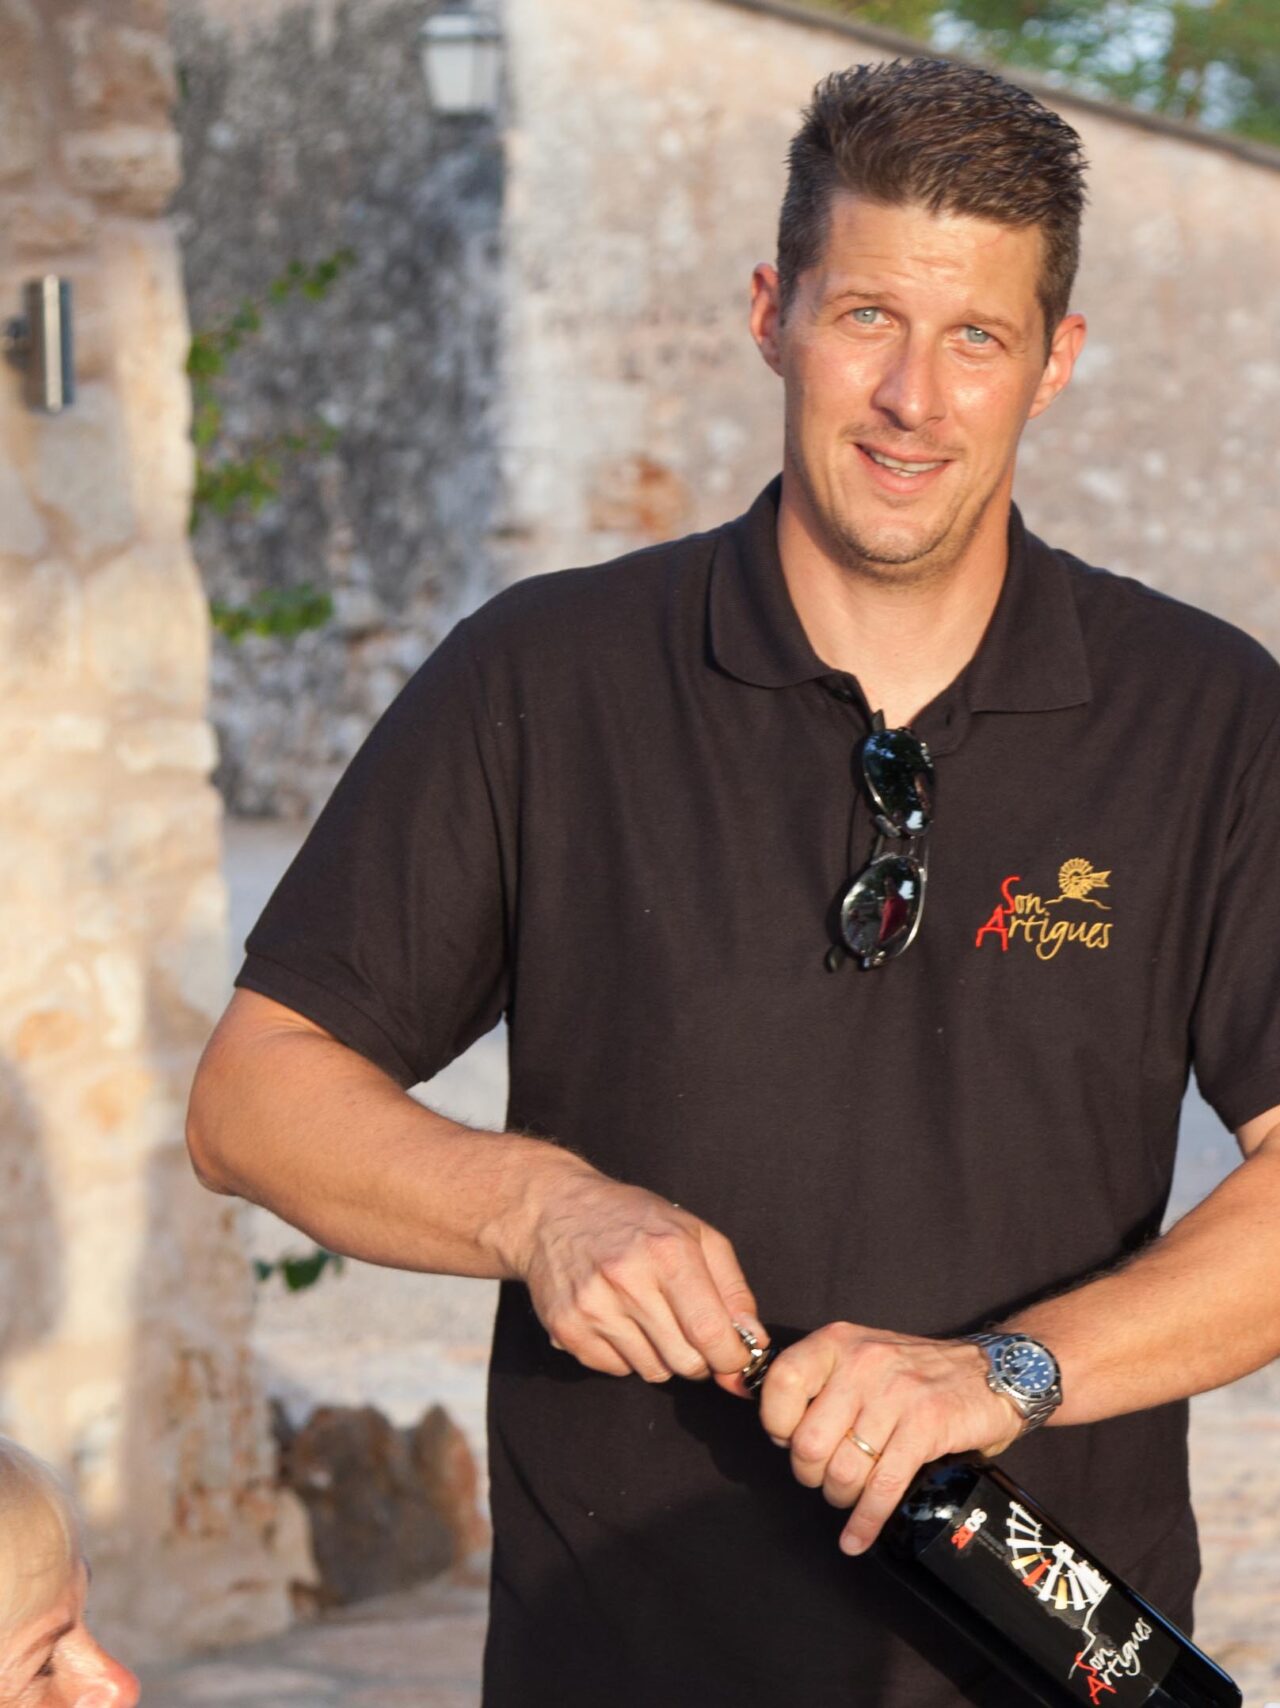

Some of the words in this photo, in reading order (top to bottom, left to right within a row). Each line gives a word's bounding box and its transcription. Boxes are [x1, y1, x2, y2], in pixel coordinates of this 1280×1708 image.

[1001, 875, 1046, 914] Son
[975, 904, 1113, 960] Artigues
[951, 1508, 988, 1550] 2006
[1075, 1648, 1117, 1677] Son
[1087, 1617, 1153, 1706] Artigues
